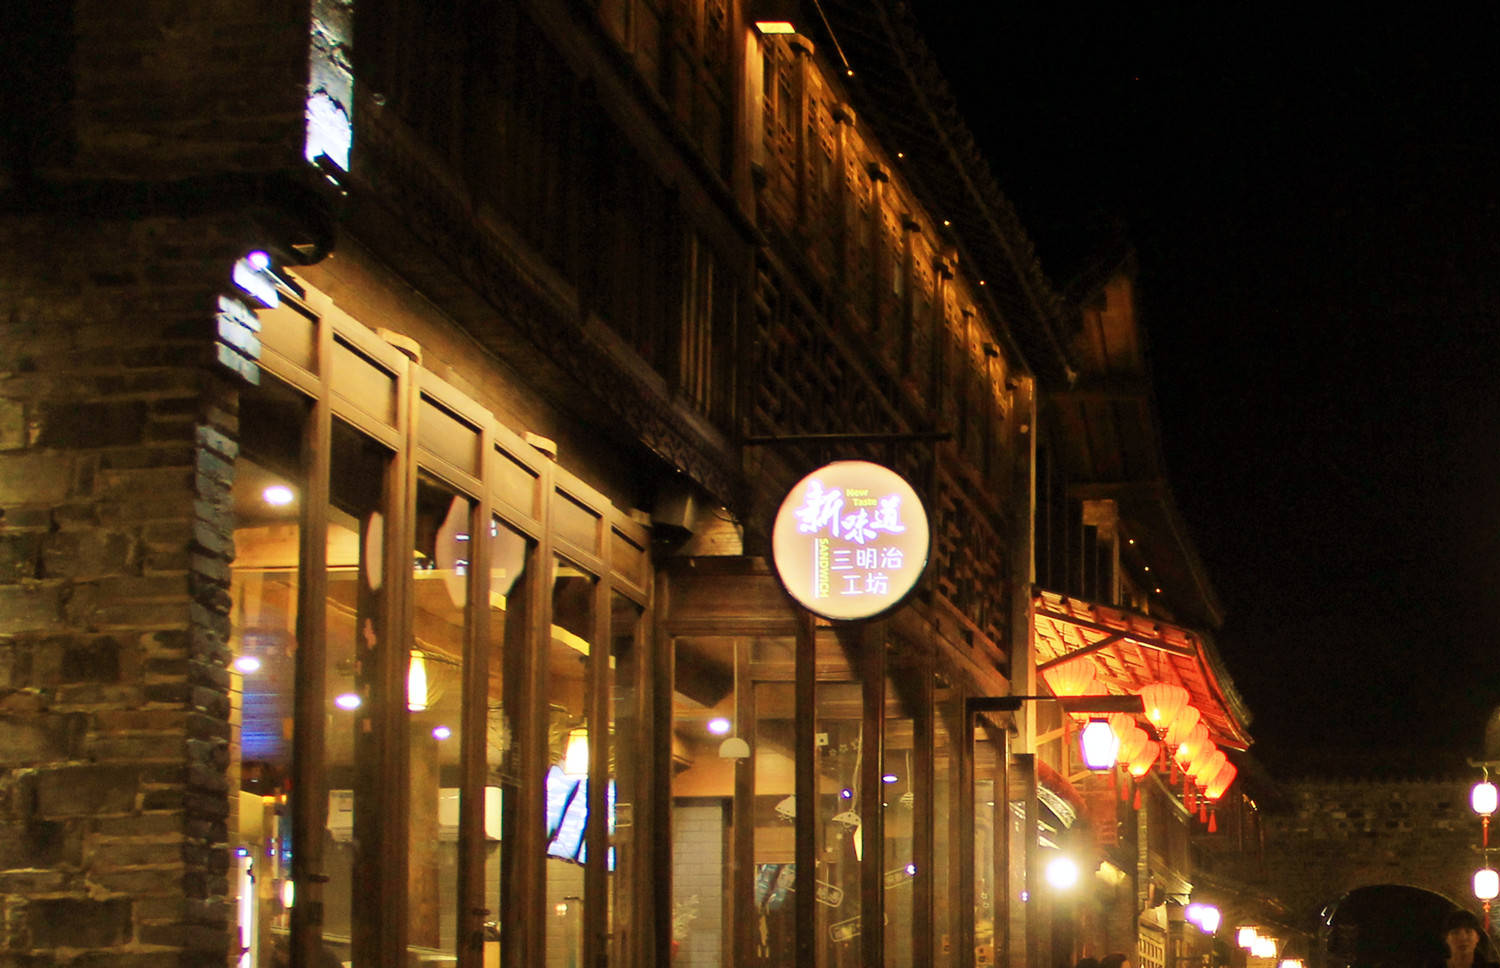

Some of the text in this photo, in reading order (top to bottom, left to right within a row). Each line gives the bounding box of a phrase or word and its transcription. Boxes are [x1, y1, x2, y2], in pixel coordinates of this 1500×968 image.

[845, 488, 869, 497] New
[853, 498, 878, 507] Taste
[795, 479, 906, 545] 新味道
[819, 537, 830, 598] SANDWICH
[831, 546, 904, 570] 三明治
[840, 571, 889, 596] 工坊
